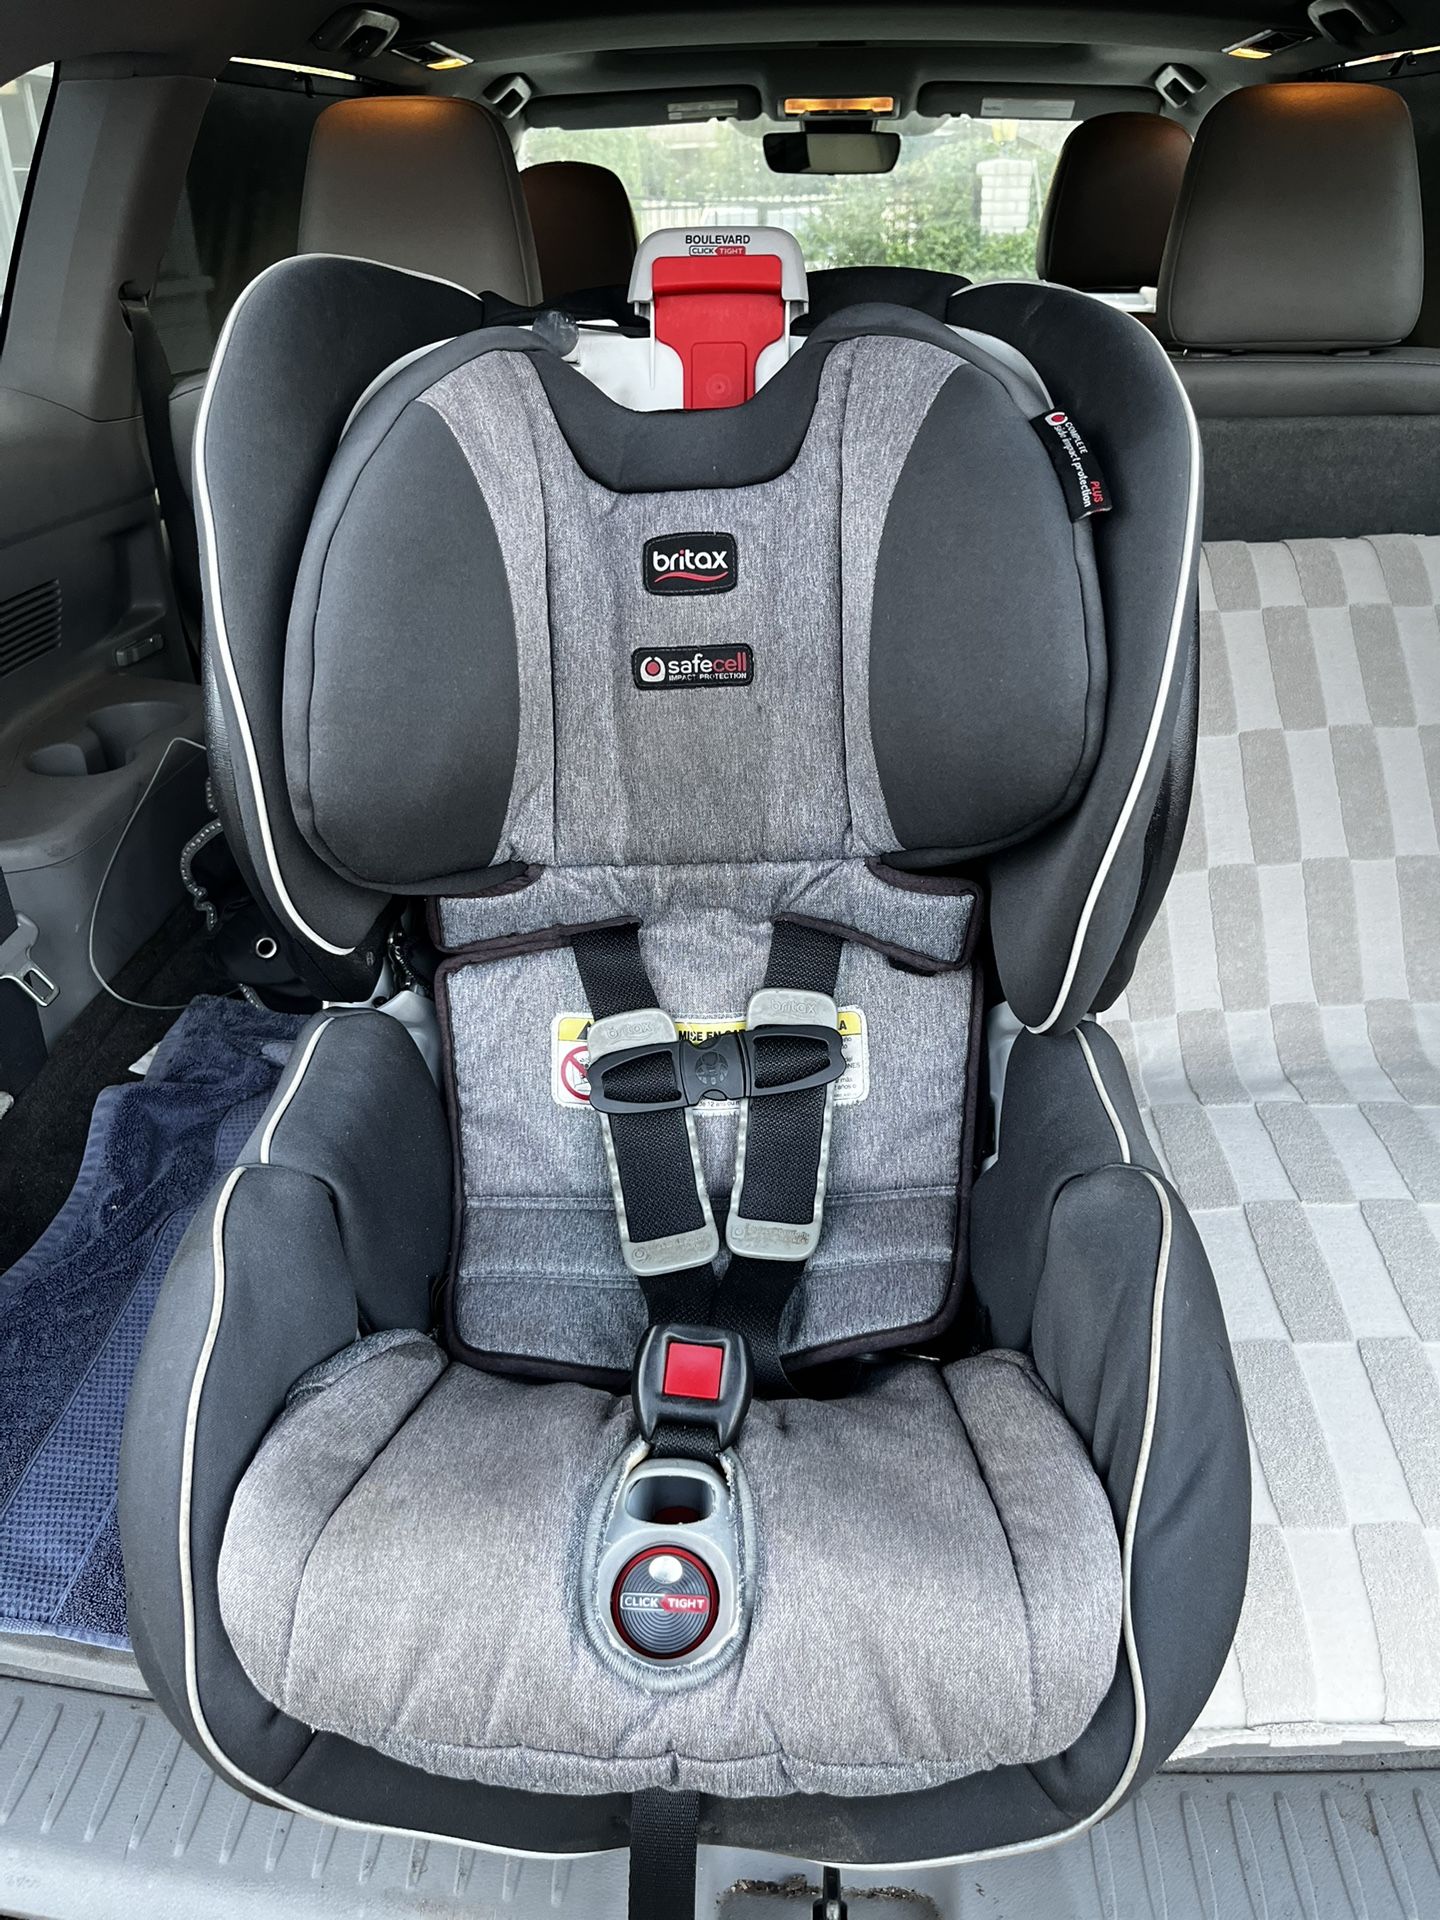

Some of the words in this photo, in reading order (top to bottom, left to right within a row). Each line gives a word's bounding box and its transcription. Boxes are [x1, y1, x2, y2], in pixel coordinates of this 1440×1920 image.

[685, 234, 751, 245] BOULEVARD
[719, 246, 744, 254] TIGHT
[1065, 422, 1088, 454] COMPLETE
[1090, 480, 1104, 503] PLUS
[1061, 437, 1081, 462] impact
[1071, 462, 1092, 508] protection
[652, 548, 729, 572] britax
[667, 652, 747, 674] safecell
[668, 673, 696, 682] IMPACT
[699, 671, 747, 680] PROTECTION
[771, 999, 817, 1014] britax
[679, 1030, 703, 1041] MISE
[624, 1596, 659, 1608] CLICK
[667, 1598, 705, 1609] TIGHT
